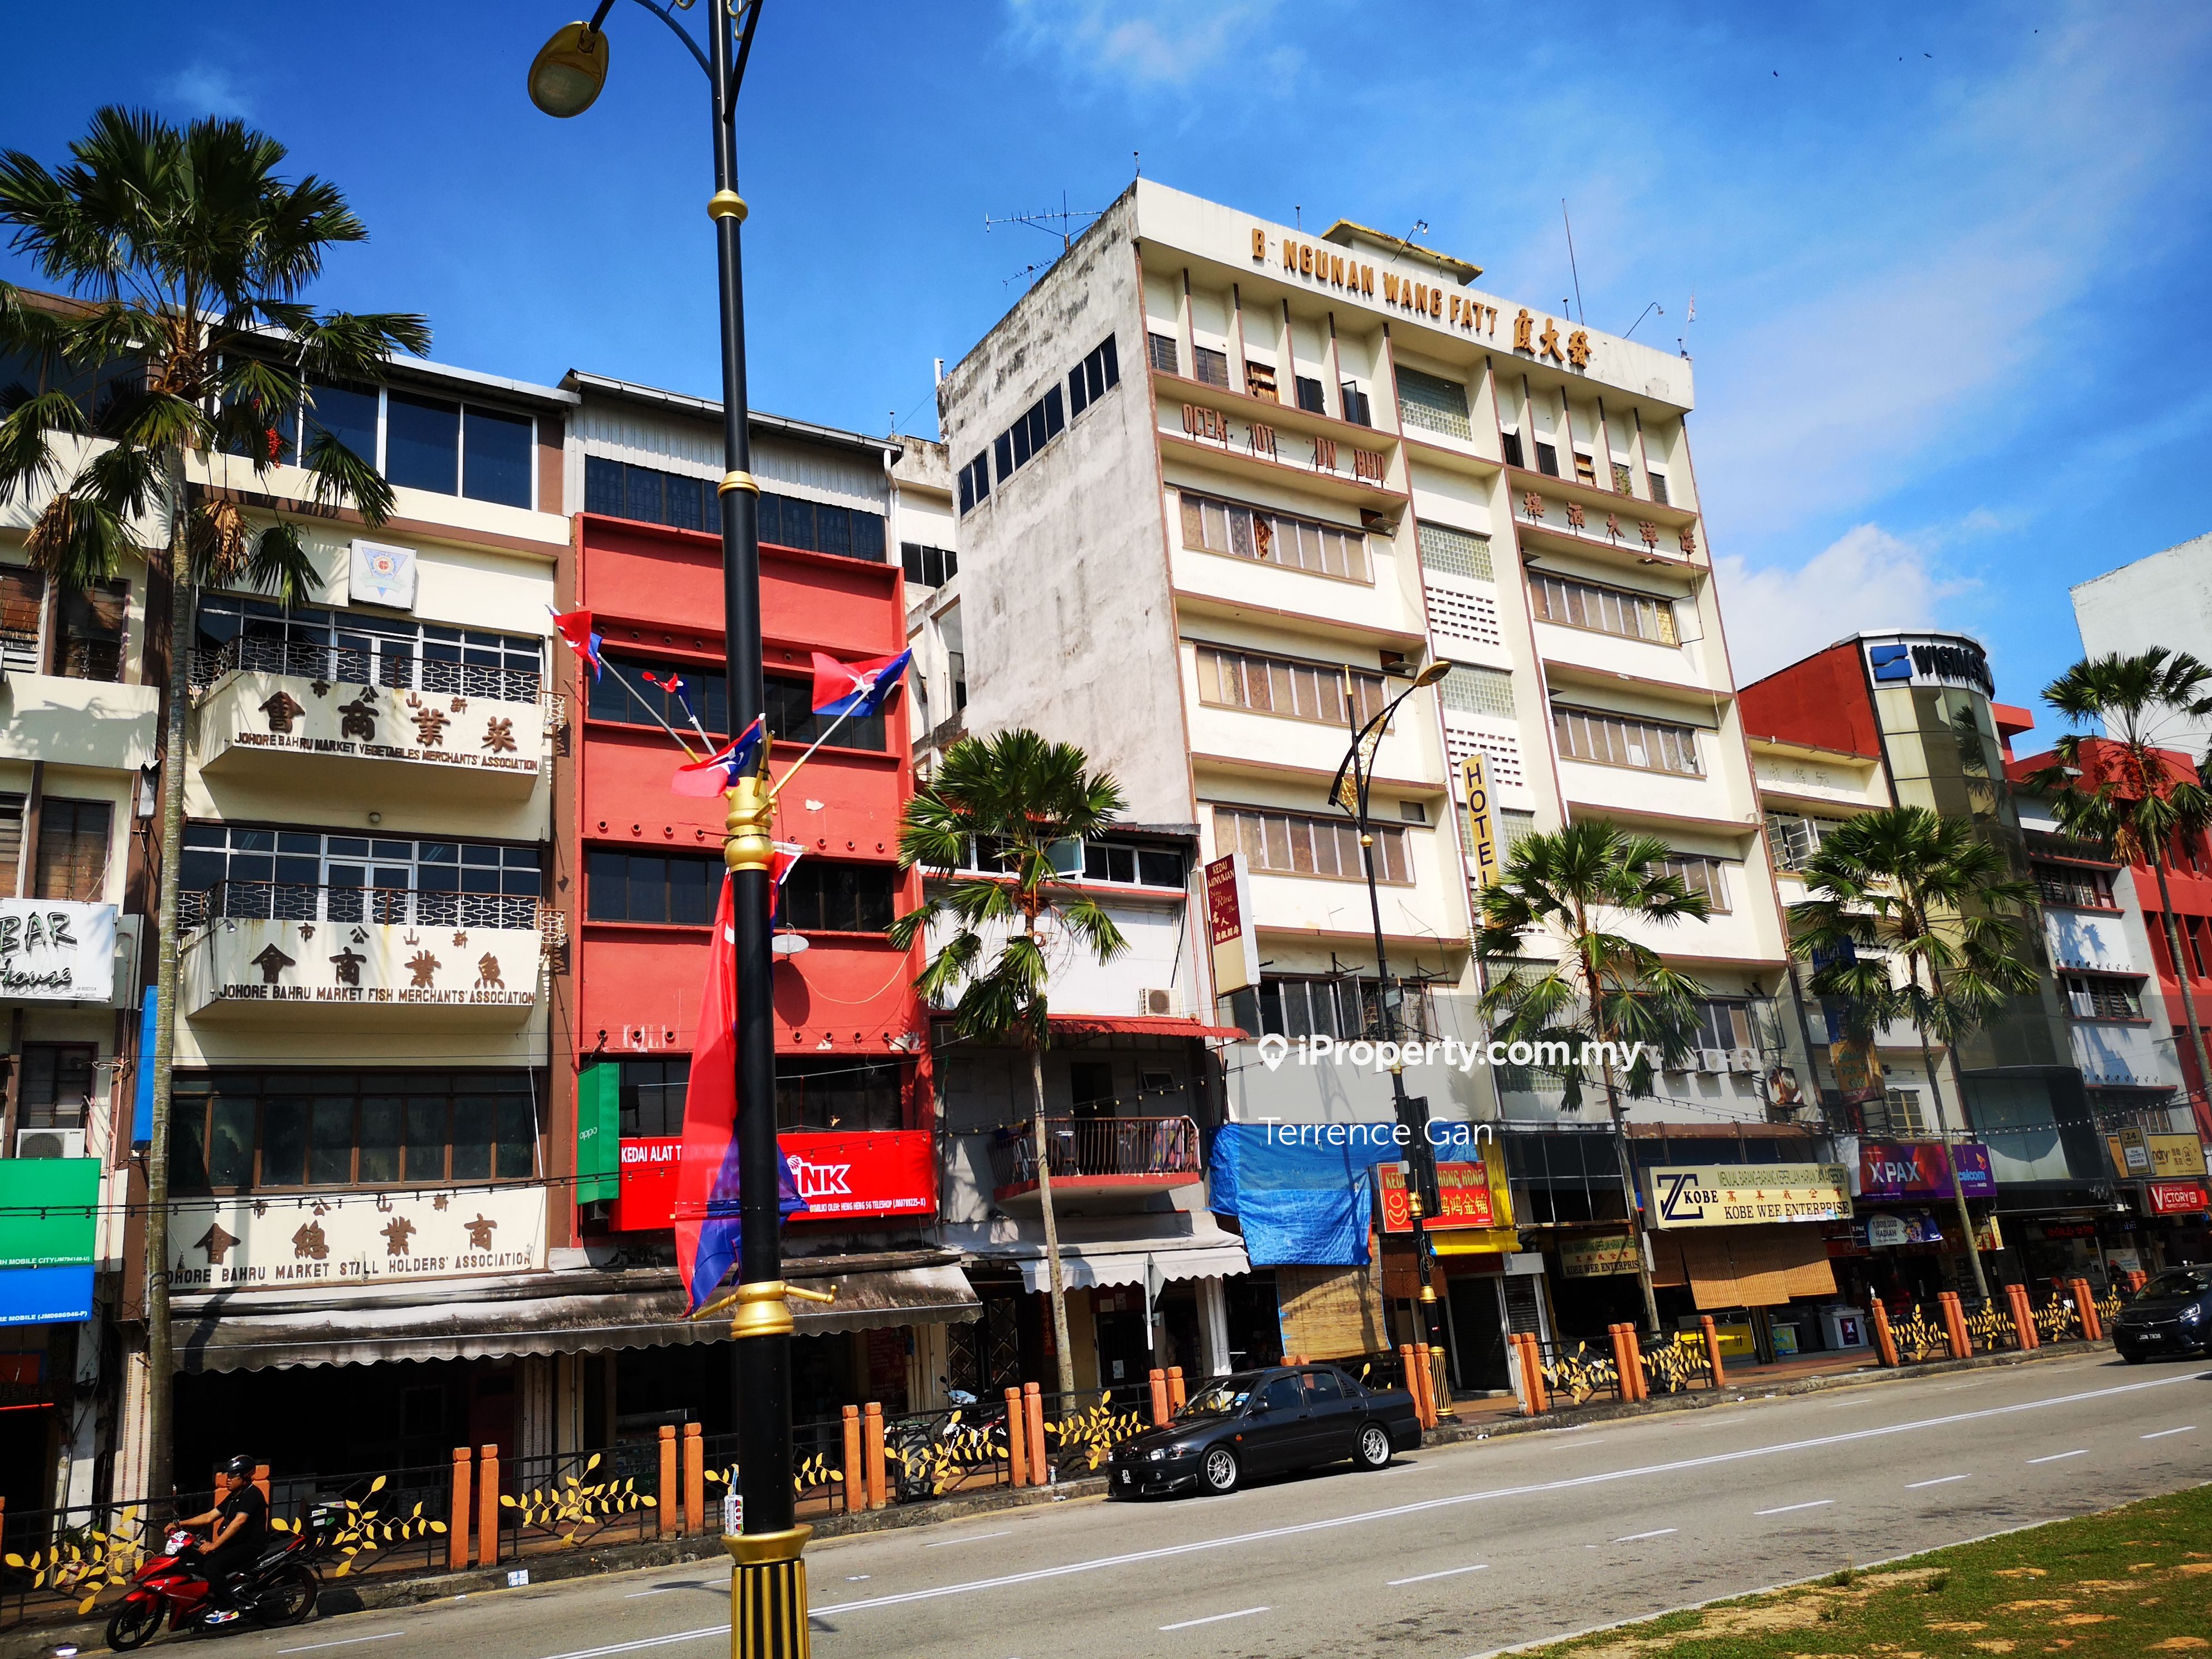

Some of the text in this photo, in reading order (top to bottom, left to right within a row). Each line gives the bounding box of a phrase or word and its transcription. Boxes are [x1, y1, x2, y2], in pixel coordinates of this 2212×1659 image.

[1383, 271, 1443, 317] WANG
[1449, 294, 1498, 336] FATT
[235, 732, 278, 748] JOHORE
[278, 735, 313, 750] BAHRU
[315, 741, 356, 754] MARKET
[359, 743, 420, 761] VEGETABLES
[482, 755, 538, 772] ASSOCIATION
[1212, 860, 1228, 875] KEDAI
[1207, 869, 1235, 889] MINUMAN
[0, 911, 77, 952] BAR
[219, 984, 535, 1006] JOHORE BAHRU MARKET FISH MERCHANTS' ASSOCIATION
[579, 1127, 598, 1141] oppo
[621, 1146, 647, 1163] KEDAI
[650, 1145, 673, 1162] ALAT
[1437, 1170, 1459, 1187] HONG
[1462, 1168, 1484, 1185] HONG
[1684, 1190, 1719, 1205] KOBE
[2151, 1186, 2189, 1210] VICTORY
[1724, 1201, 1850, 1219] KOBE WEE ENTERPRISE
[168, 1268, 211, 1284] OHORE
[221, 1266, 266, 1282] BAHRU
[276, 1262, 330, 1280] MARKET
[389, 1257, 450, 1273] HOLDERS'
[455, 1253, 531, 1269] ASSOCIATION
[1584, 1263, 1599, 1273] WEE
[1601, 1259, 1639, 1272] ENTERPRIS
